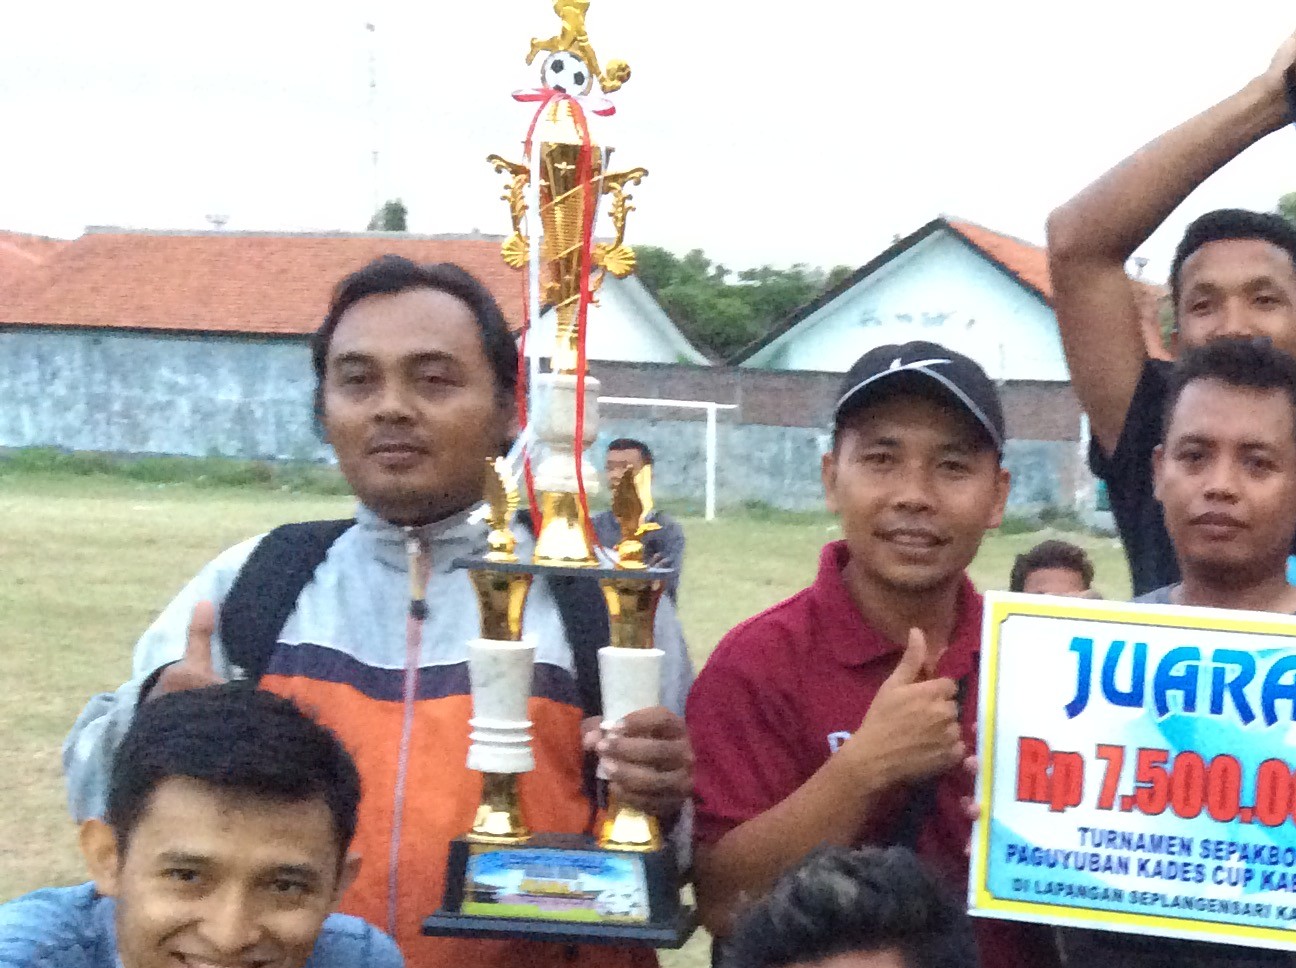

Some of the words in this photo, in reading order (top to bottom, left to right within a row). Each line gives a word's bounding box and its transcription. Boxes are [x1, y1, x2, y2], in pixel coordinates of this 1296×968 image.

[1015, 736, 1085, 813] Rp
[1077, 826, 1193, 857] TURNAMEN
[1005, 843, 1130, 876] PAGUYUBAN
[1136, 857, 1206, 884] KADES
[1211, 865, 1255, 887] CUP
[1012, 877, 1030, 893] DI
[1034, 880, 1124, 904] LAPANGAN
